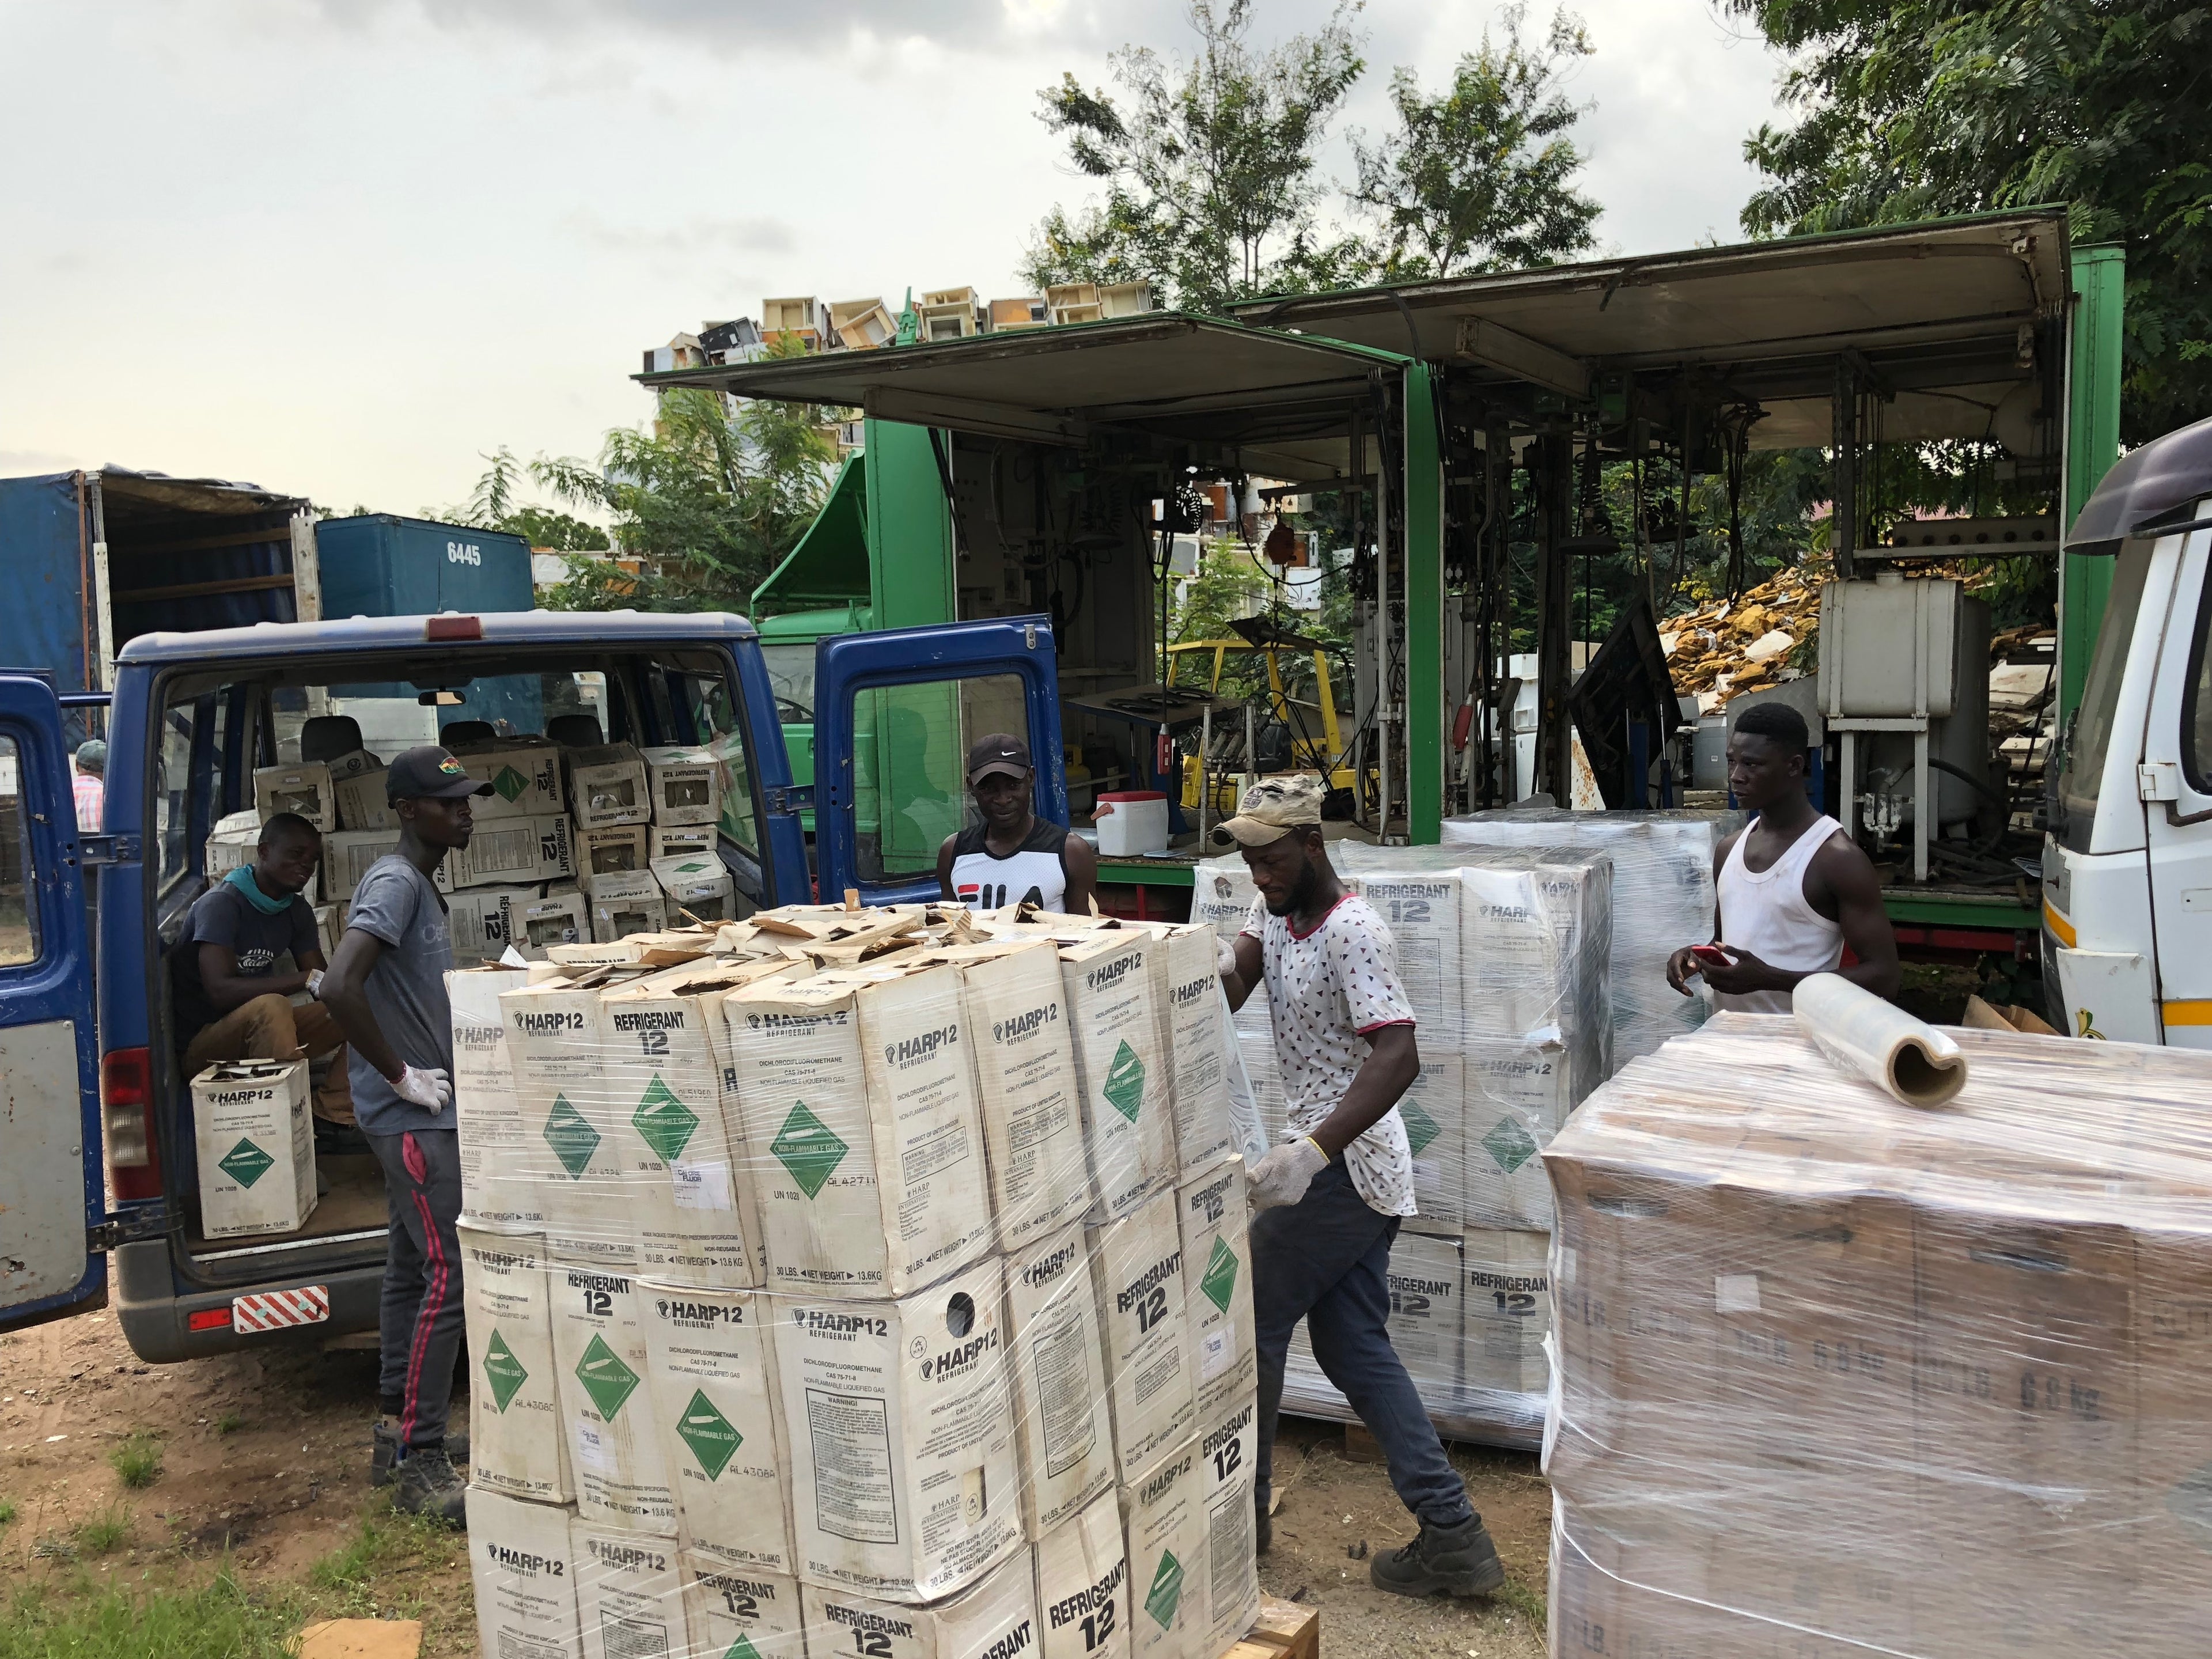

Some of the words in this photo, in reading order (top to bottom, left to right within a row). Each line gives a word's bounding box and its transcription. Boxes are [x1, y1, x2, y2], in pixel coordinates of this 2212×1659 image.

[447, 541, 481, 566] 6445
[537, 772, 547, 791] 12
[545, 759, 557, 801] REFRIGERANT
[676, 769, 710, 777] REFRIGERANT
[590, 812, 625, 822] REFRIGERANT
[541, 832, 557, 861] 12
[555, 818, 569, 872] REFRIGERANT
[1366, 884, 1450, 899] REFRIGERANT
[1386, 900, 1431, 922] 12
[484, 911, 501, 940] 12
[1097, 952, 1142, 986] HARP12
[1097, 976, 1126, 993] REFRIGERANT
[1178, 974, 1214, 1002] HARP12
[526, 1013, 584, 1030] HARP12
[613, 1012, 684, 1031] REFRIGERANT
[764, 1010, 847, 1028] HARP12
[1005, 1003, 1058, 1039] HARP12
[767, 1028, 816, 1037] REFRIGERANT
[1007, 1028, 1040, 1047] REFRIGERANT
[638, 1030, 670, 1055] 12
[899, 1024, 957, 1062] HARP12
[900, 1051, 937, 1070] REFRIGERANT
[1490, 1062, 1552, 1075] HARP12
[1025, 1070, 1033, 1078] CAS
[218, 1090, 273, 1103] HARP12
[919, 1095, 929, 1104] CAS
[1013, 1106, 1031, 1116] PRODUCT
[1037, 1098, 1048, 1107] UNITED
[907, 1134, 926, 1146] PRODUCT
[933, 1126, 945, 1135] UNITED
[945, 1118, 959, 1129] KINGDOM
[1017, 1150, 1035, 1162] HARP
[639, 1162, 648, 1171] UN
[1004, 1159, 1037, 1176] INTERNATIONAL
[774, 1191, 785, 1199] UN
[912, 1182, 930, 1196] HARP
[1131, 1185, 1141, 1198] NET
[1191, 1173, 1233, 1212] REFRIGERANT
[898, 1193, 930, 1210] INTERNATIONAL
[1204, 1195, 1225, 1224] 12
[493, 1213, 515, 1221] WEIGHT
[1012, 1226, 1019, 1236] 30
[1020, 1220, 1032, 1233] LBS.
[1039, 1210, 1050, 1224] NET
[482, 1251, 535, 1269] HARP12
[645, 1254, 652, 1263] 30
[653, 1255, 665, 1263] LBS.
[676, 1256, 686, 1264] NET
[686, 1256, 709, 1266] WEIGHT
[720, 1258, 732, 1266] 13.6
[906, 1264, 912, 1275] 30
[912, 1257, 925, 1272] LBS.
[932, 1247, 942, 1262] NET
[942, 1238, 962, 1255] WEIGHT
[1033, 1242, 1074, 1283] HARP12
[777, 1267, 783, 1275] 30
[785, 1267, 799, 1277] LBS.
[806, 1269, 817, 1279] NET
[819, 1270, 844, 1280] WEIGHT
[858, 1271, 882, 1281] 13.6KG
[1117, 1251, 1180, 1313] REFRIGERANT
[568, 1274, 630, 1294] REFRIGERANT
[583, 1290, 613, 1316] 12
[672, 1302, 743, 1323] HARP12
[1135, 1286, 1168, 1335] 12
[1390, 1291, 1430, 1318] 12
[1491, 1291, 1536, 1316] 12
[809, 1311, 887, 1336] HARP12
[1201, 1320, 1209, 1329] UN
[1209, 1313, 1219, 1324] 1028
[810, 1330, 857, 1342] REFRIGERANT
[669, 1346, 739, 1359] DICHLORODIFLUOROMETHANE
[937, 1327, 997, 1375] HARP12
[704, 1369, 729, 1378] LIQUEFIED
[804, 1358, 882, 1373] DICHLORODIFLUOROMETHANE
[937, 1360, 979, 1384] REFRIGERANT
[804, 1377, 842, 1389] NON-FLAMMABLE
[843, 1384, 872, 1392] LIQUEFIED
[828, 1396, 858, 1407] WARNING!
[683, 1426, 722, 1440] NON-FLAMMABLE
[724, 1433, 735, 1441] GAS
[931, 1413, 972, 1435] NON-FLAMMABLE
[1126, 1457, 1133, 1467] 30
[1150, 1441, 1160, 1449] NET
[1160, 1425, 1174, 1444] WEIGHT
[1187, 1408, 1193, 1419] KG
[938, 1446, 960, 1459] PRODUCT
[961, 1441, 968, 1449] OF
[1213, 1437, 1242, 1483] 12
[683, 1468, 691, 1477] UN
[693, 1470, 706, 1481] 1028
[1147, 1456, 1192, 1501] HARP12
[938, 1494, 960, 1509] HARP
[922, 1505, 961, 1525] INTERNATIONAL
[1040, 1514, 1048, 1525] 30
[1048, 1508, 1060, 1521] LBS.
[726, 1547, 749, 1559] WEIGHT
[955, 1541, 964, 1550] NOT
[499, 1547, 563, 1577] HARP12
[600, 1542, 666, 1571] HARP12
[949, 1551, 959, 1561] PAS
[695, 1569, 776, 1600] REFRIGERANT
[839, 1569, 851, 1579] NET
[852, 1574, 878, 1585] WEIGHT
[930, 1577, 938, 1588] 30
[940, 1570, 955, 1583] LBS.
[1049, 1556, 1125, 1630] REFRIGERANT
[721, 1590, 760, 1619] 12
[825, 1603, 912, 1639] REFRIGERANT
[1078, 1599, 1116, 1653] 12
[851, 1627, 893, 1658] 12
